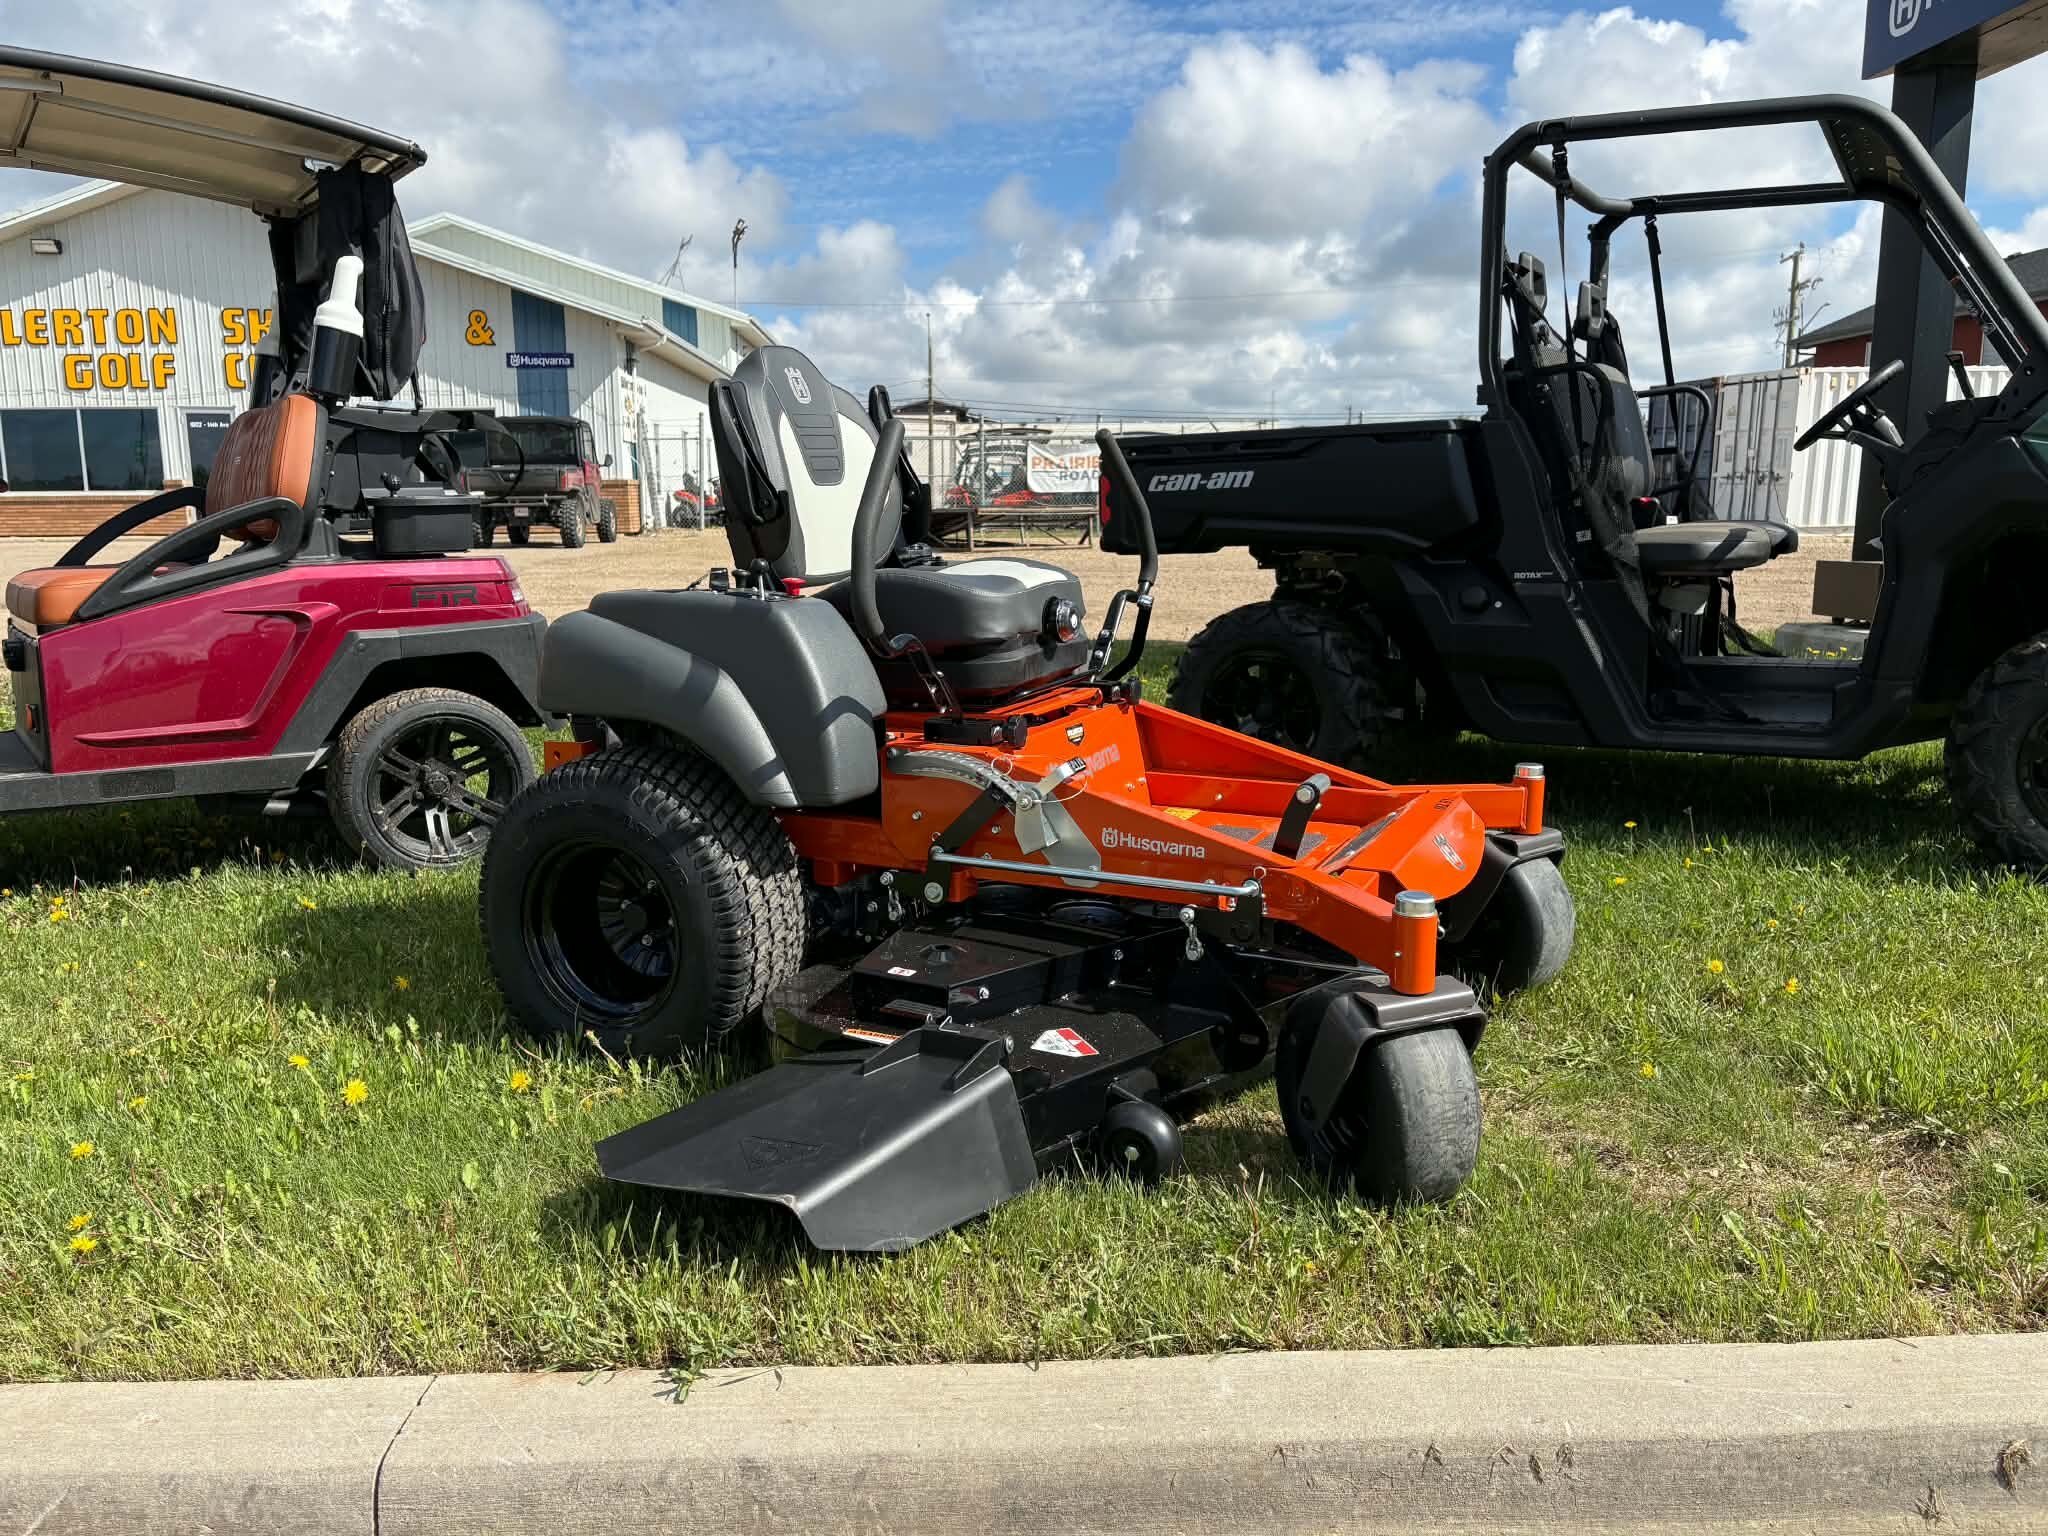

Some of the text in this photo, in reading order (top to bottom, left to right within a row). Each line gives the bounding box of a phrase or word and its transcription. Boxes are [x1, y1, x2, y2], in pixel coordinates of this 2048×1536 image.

[0, 308, 177, 345] LERTON
[465, 309, 496, 346] &
[64, 352, 257, 390] GOLF C
[520, 355, 570, 367] Husqvarna
[1147, 470, 1255, 492] can-am
[1119, 831, 1205, 858] Husqvarna
